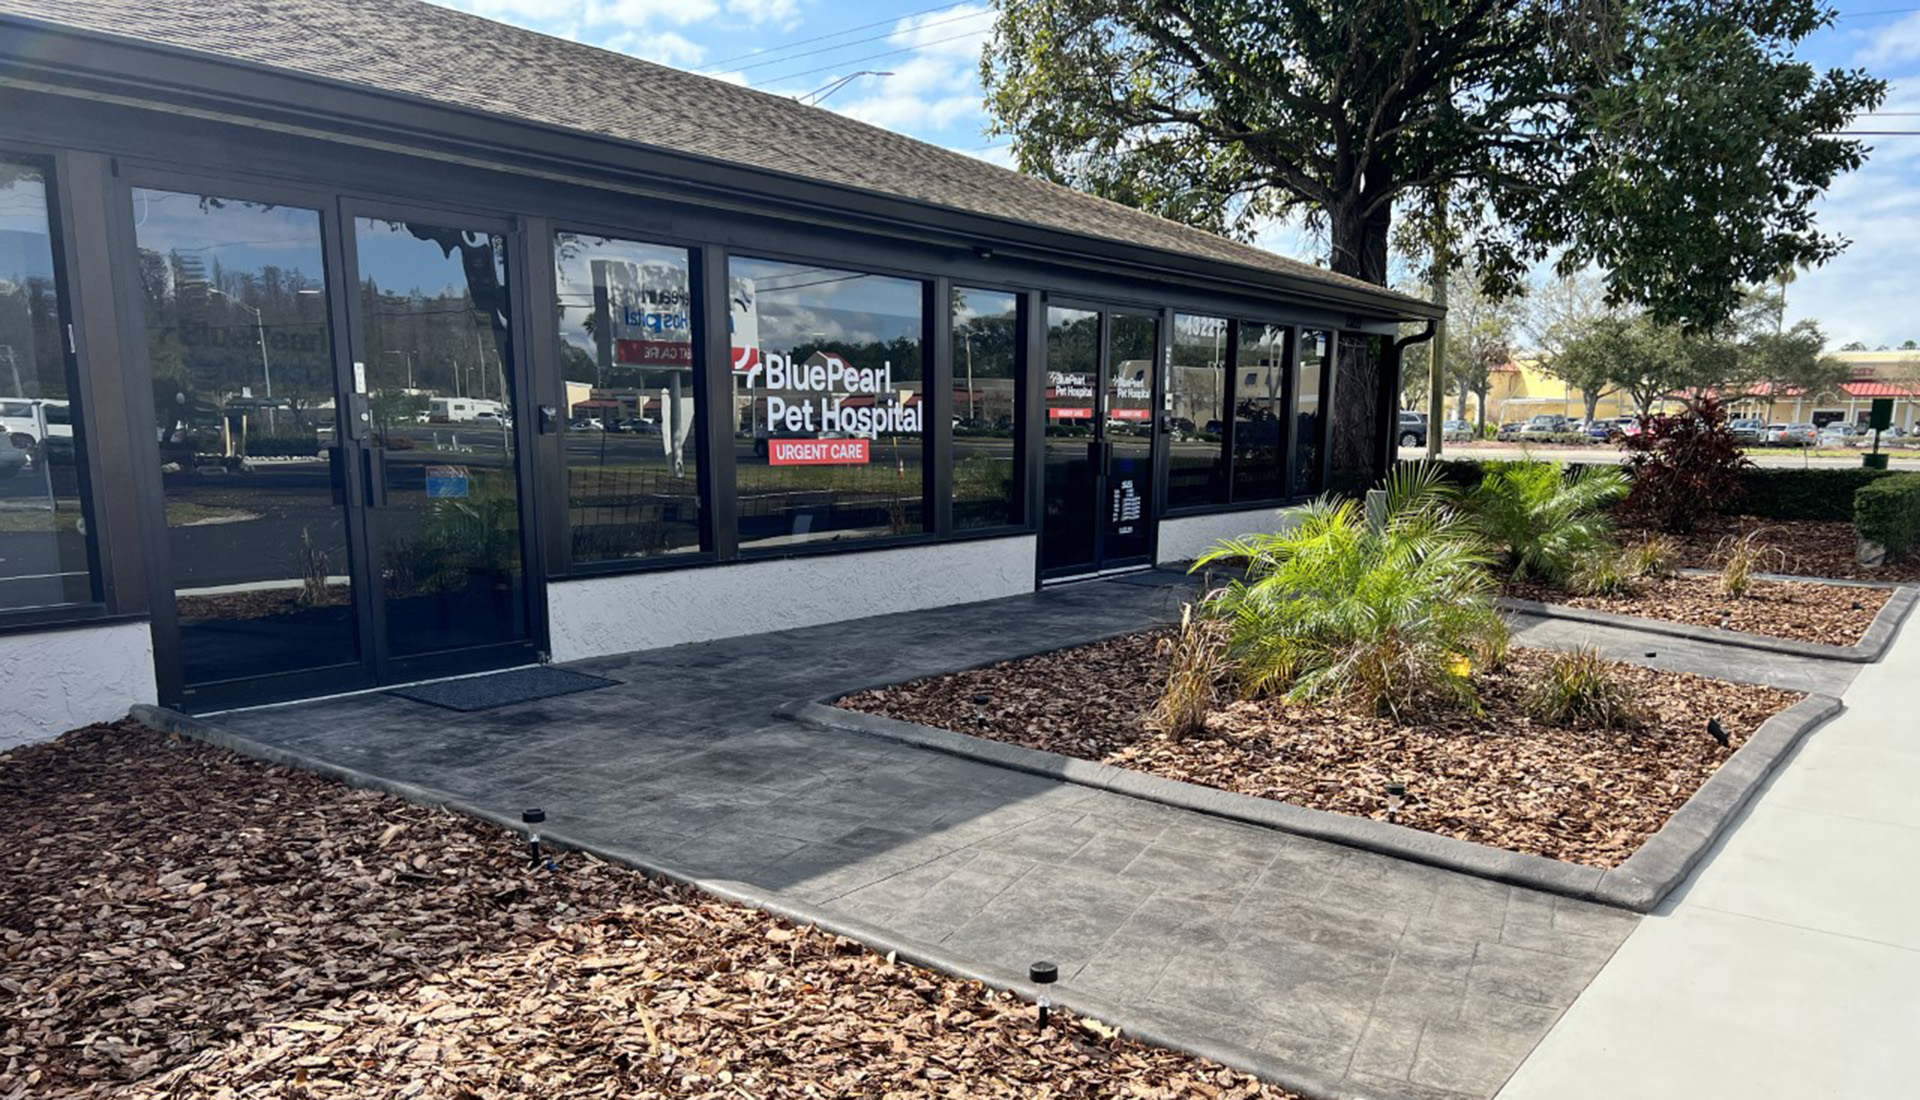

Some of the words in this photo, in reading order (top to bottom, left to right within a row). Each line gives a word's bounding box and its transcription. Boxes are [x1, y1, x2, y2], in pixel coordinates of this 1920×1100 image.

[766, 354, 891, 393] BluePearl
[1055, 373, 1086, 386] BluePearl
[1055, 385, 1067, 397] Pet
[1067, 386, 1092, 399] Hospital
[1128, 388, 1151, 401] Hospital
[767, 396, 814, 432] Pet
[822, 397, 922, 440] Hospital
[776, 445, 828, 460] URGENT
[831, 443, 863, 459] CARE
